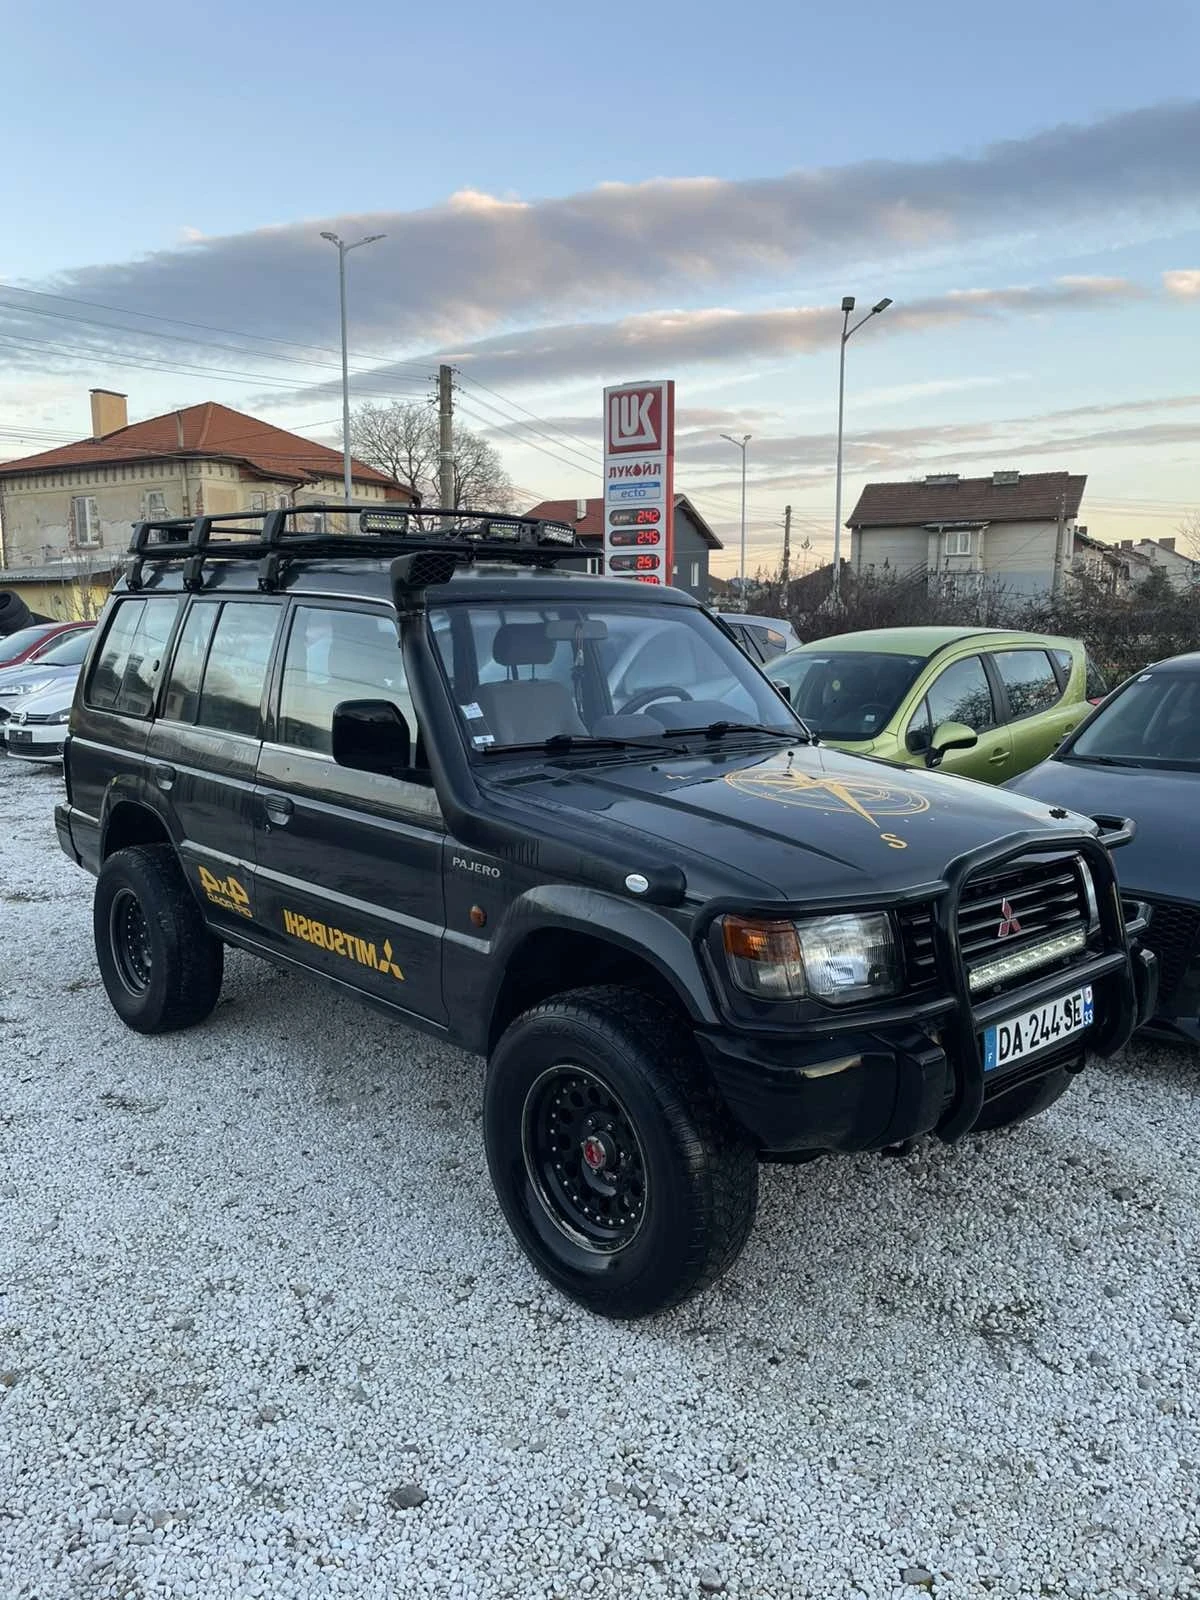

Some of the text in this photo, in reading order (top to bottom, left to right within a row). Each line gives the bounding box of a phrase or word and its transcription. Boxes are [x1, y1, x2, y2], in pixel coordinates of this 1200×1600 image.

[608, 461, 662, 478] ЛУКОЙЛ
[621, 489, 646, 498] ecto
[880, 832, 908, 849] S
[452, 856, 500, 878] PAJERO
[1083, 1009, 1094, 1025] 33
